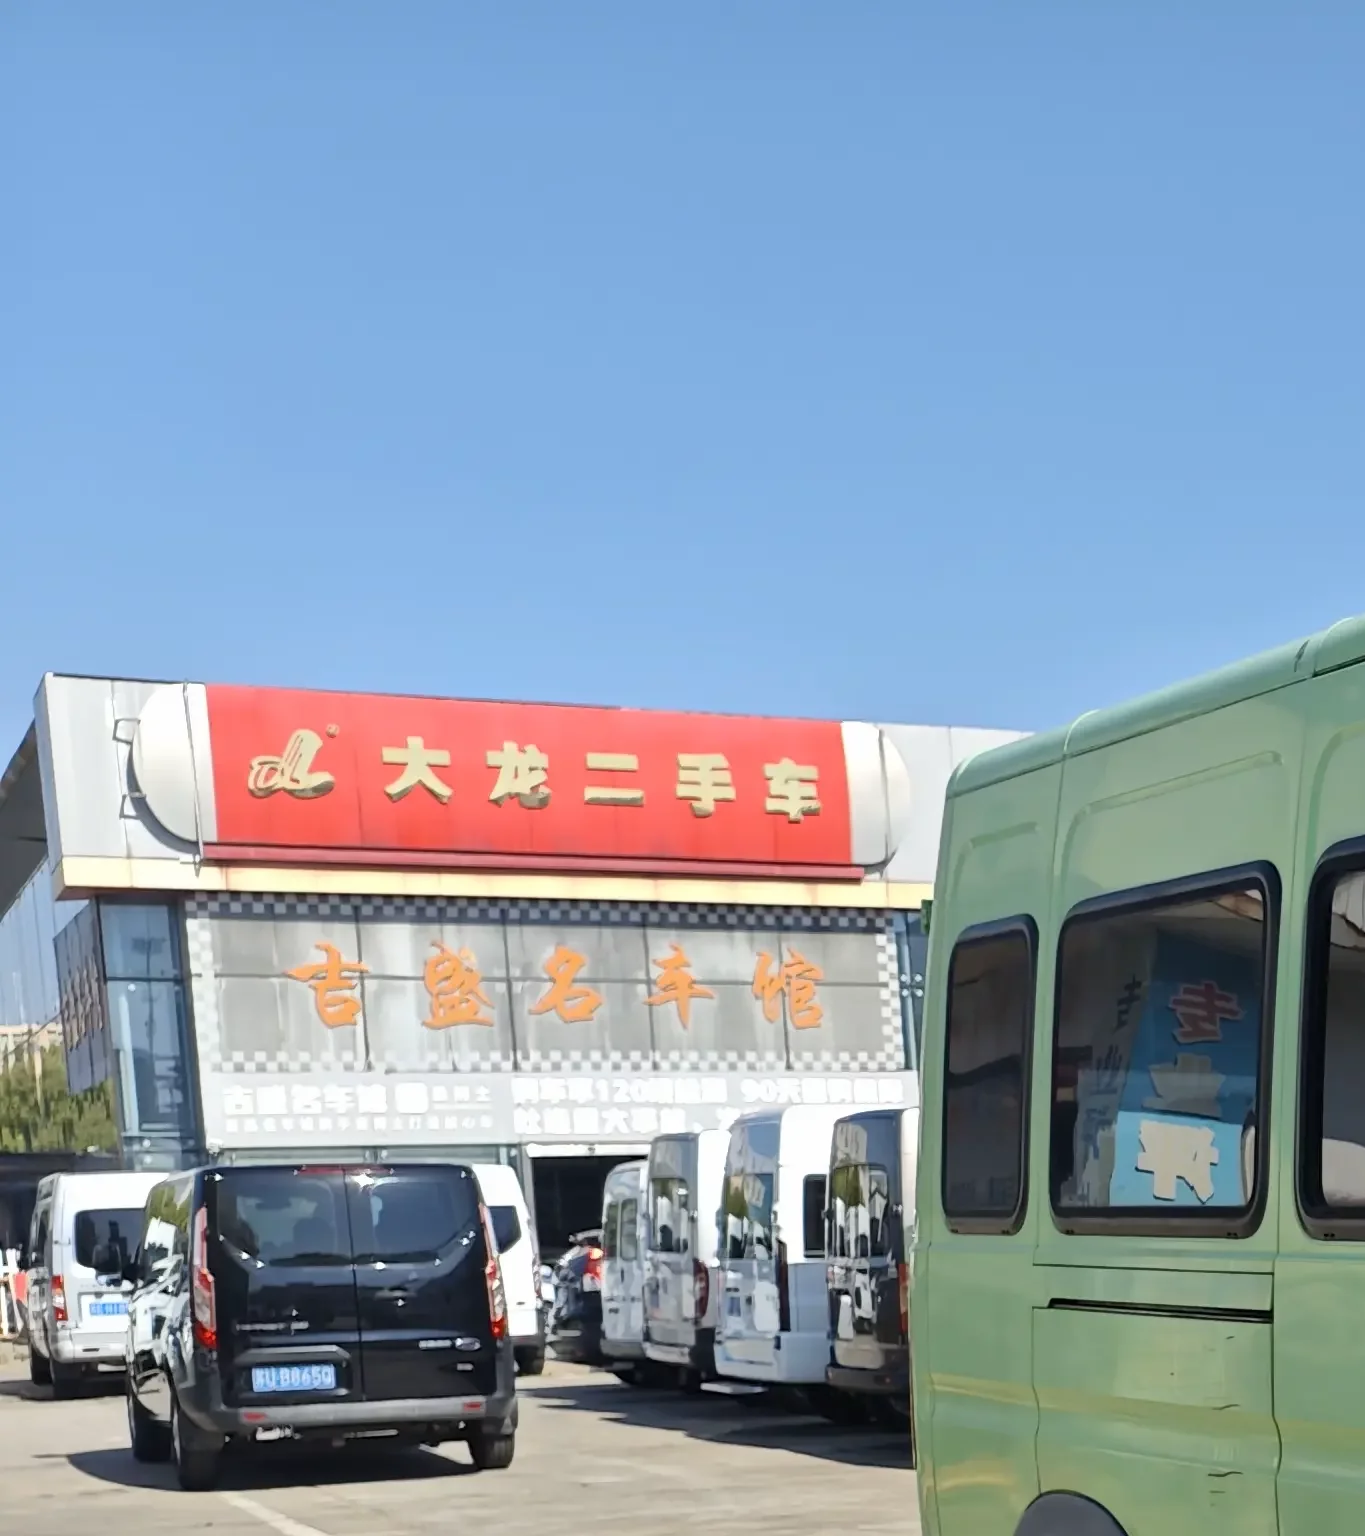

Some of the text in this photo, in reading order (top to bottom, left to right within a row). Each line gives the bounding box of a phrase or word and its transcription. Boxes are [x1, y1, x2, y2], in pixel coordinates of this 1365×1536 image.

[382, 736, 822, 825] 大龙二手车
[283, 938, 825, 1031] 吉盛名车馆
